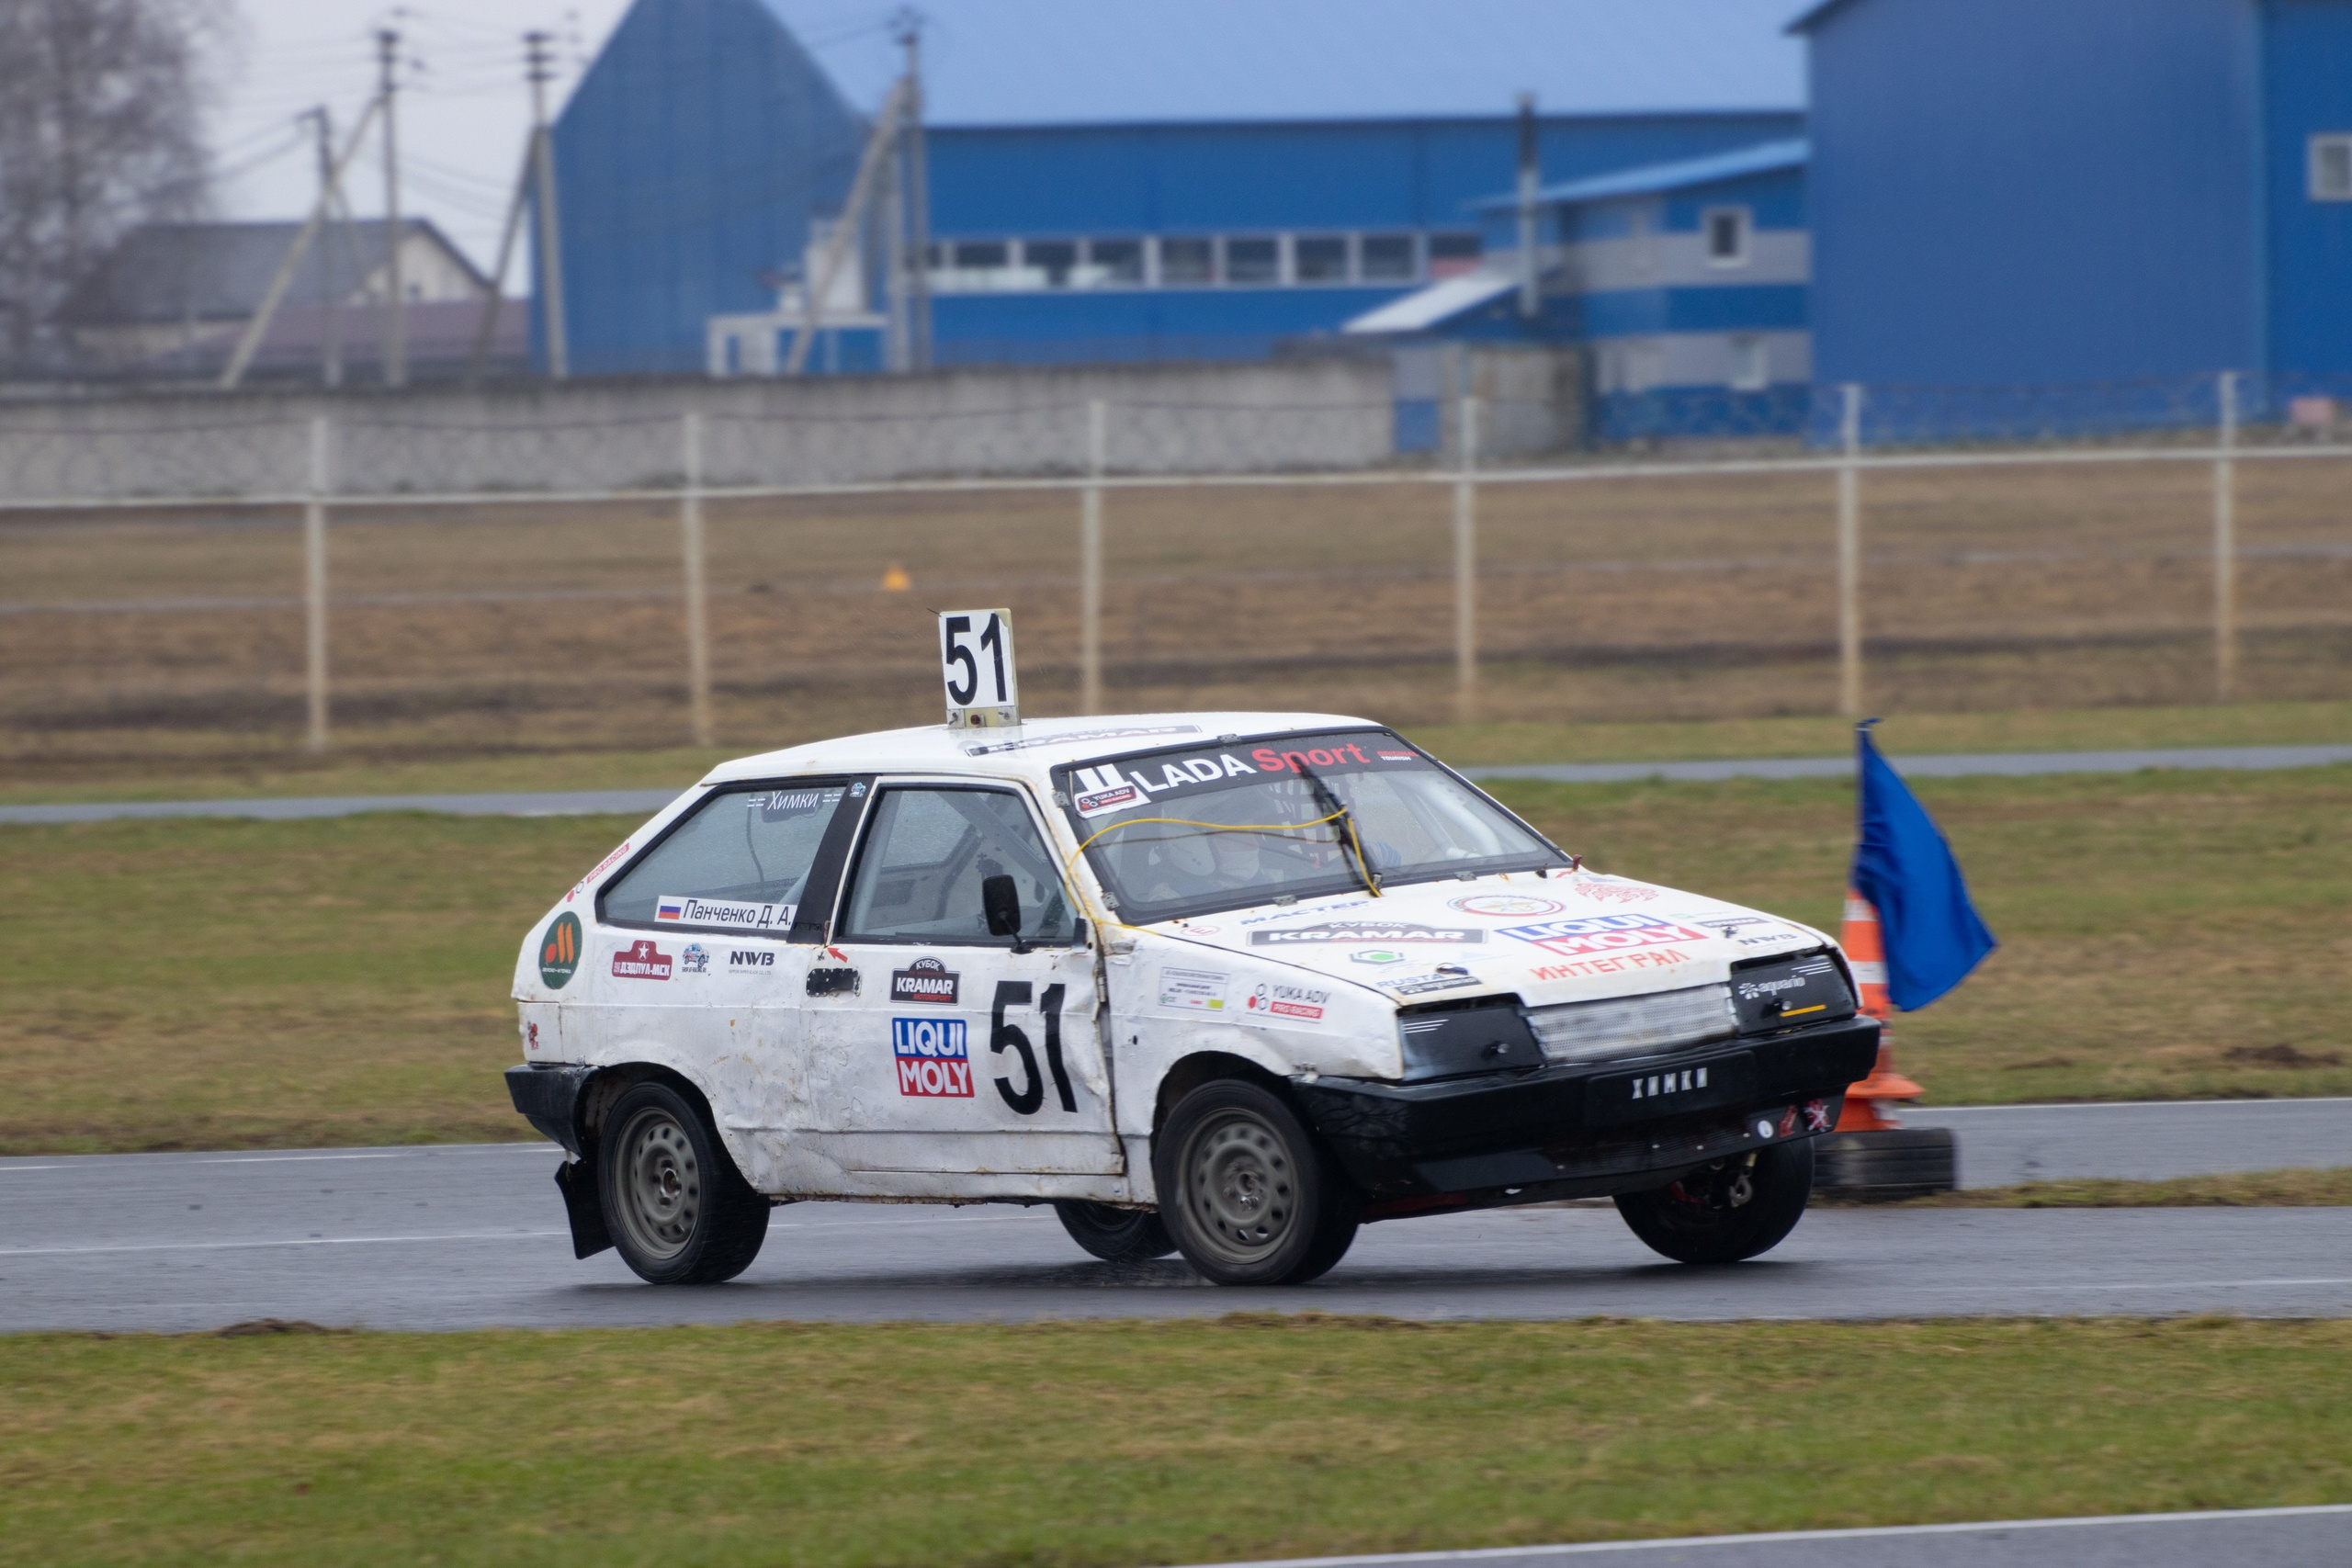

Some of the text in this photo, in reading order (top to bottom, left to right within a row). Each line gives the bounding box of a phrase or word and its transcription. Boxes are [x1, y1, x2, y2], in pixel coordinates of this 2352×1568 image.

[946, 613, 1007, 705] 51
[1129, 743, 1371, 793] LADA Sport
[683, 899, 791, 928] Панченко Д. А.
[1240, 900, 1369, 925] МАСТЕР
[1268, 930, 1465, 941] KRAMAR
[1502, 914, 1663, 941] LIQUI
[1541, 925, 1697, 955] MOLY
[1738, 933, 1797, 946] NWB
[729, 951, 775, 966] NWB
[916, 959, 941, 971] КУБОК
[1530, 949, 1690, 981] ИНТЕГРАЛ
[897, 976, 954, 995] KRAMAR
[1272, 985, 1305, 999] YUKA
[1758, 975, 1806, 996] aquario
[895, 1021, 964, 1057] LIQUI
[989, 980, 1078, 1115] 51
[899, 1060, 968, 1094] MOLY
[1632, 1067, 1707, 1100] ХИМКИ
